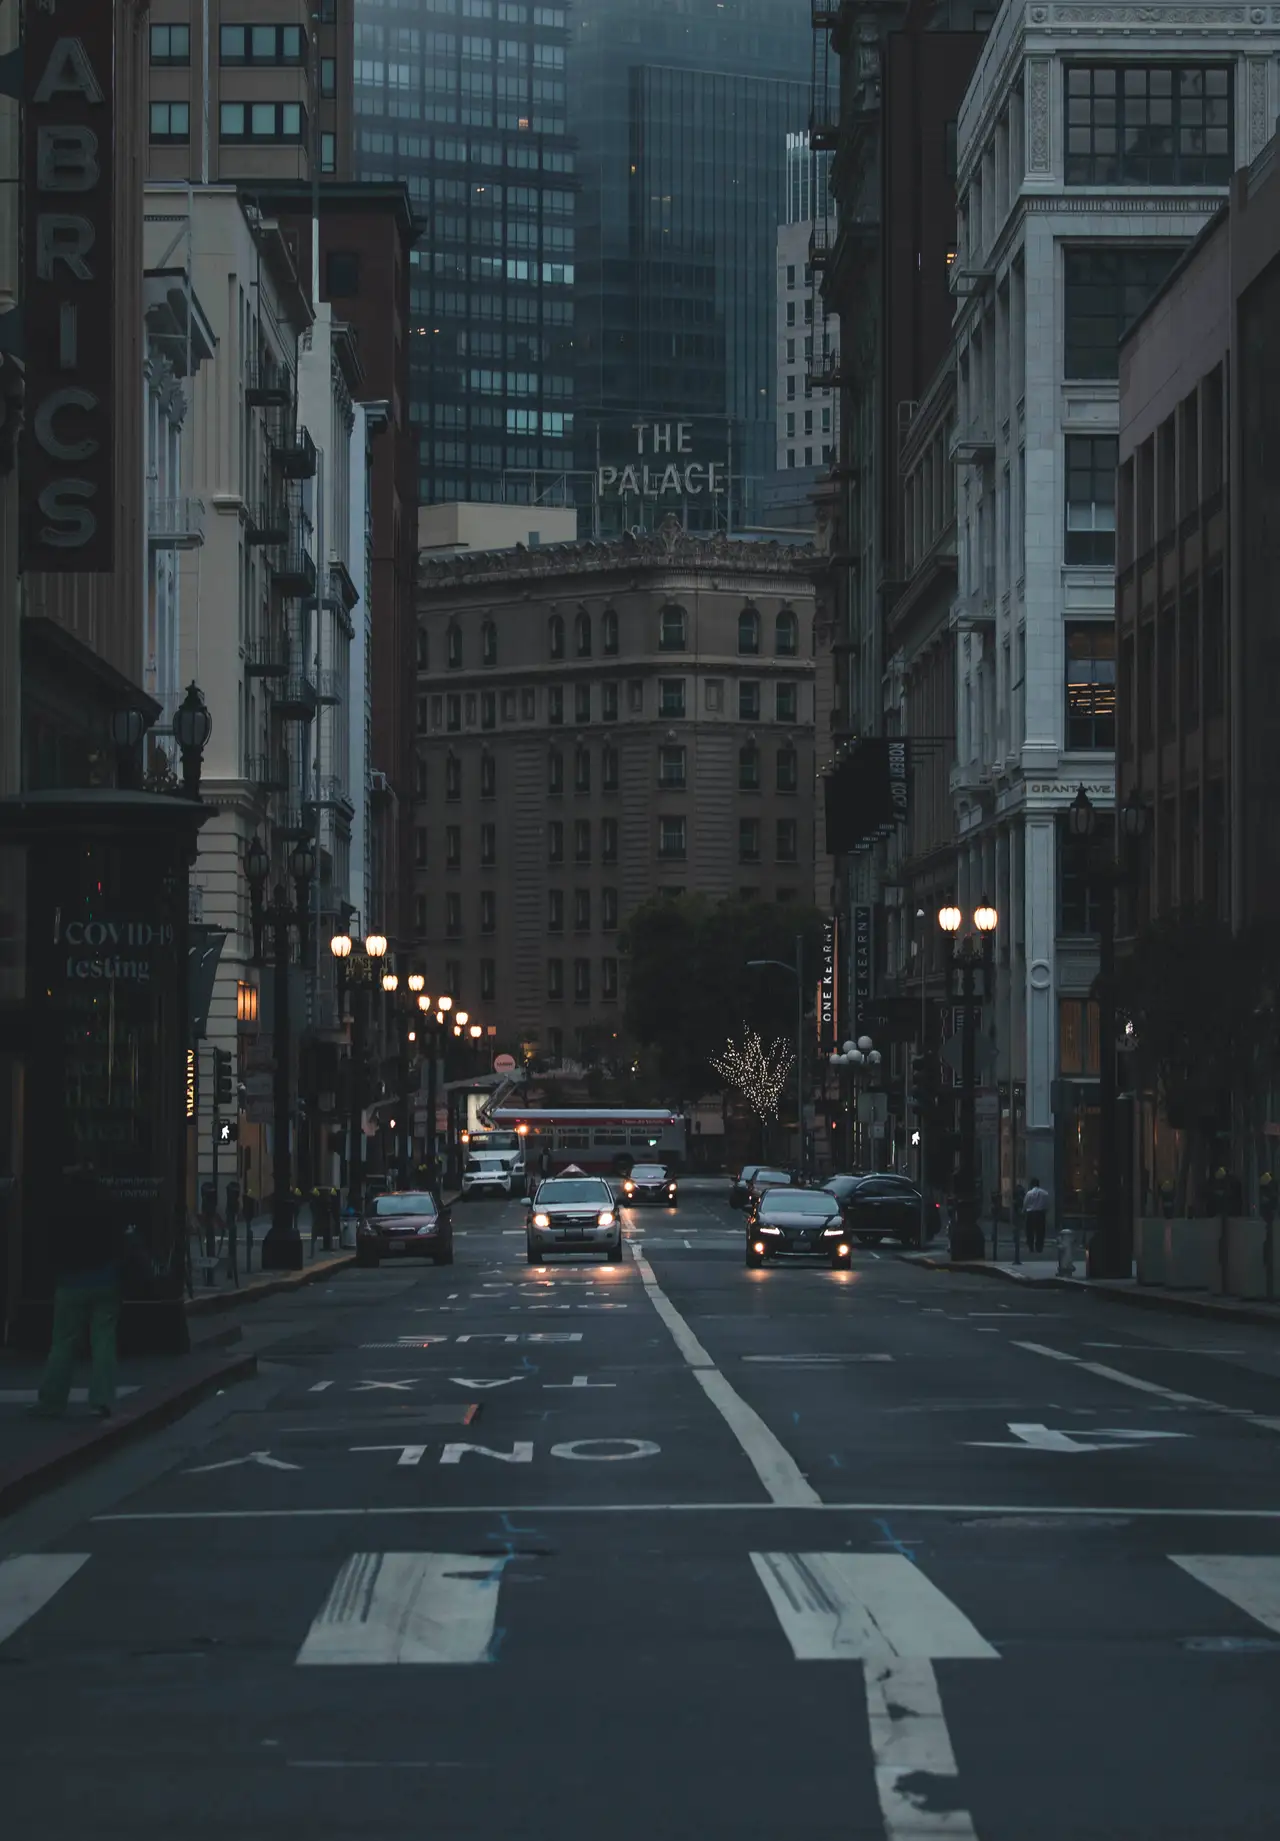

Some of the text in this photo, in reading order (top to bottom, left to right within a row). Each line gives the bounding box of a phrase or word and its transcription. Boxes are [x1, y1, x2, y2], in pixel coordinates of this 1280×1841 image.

[33, 0, 105, 548] ABRICS
[632, 422, 693, 454] THE
[598, 462, 725, 497] PALACE
[888, 742, 906, 779] ROBERT
[1031, 784, 1078, 793] GRANT
[64, 921, 173, 946] COVID-19
[857, 909, 868, 979] KEARNY
[65, 954, 150, 983] testing
[822, 923, 832, 1022] ONE KEARNY
[398, 1332, 584, 1343] BUS
[306, 1374, 617, 1392] TAXI
[180, 1437, 662, 1472] ONLY
